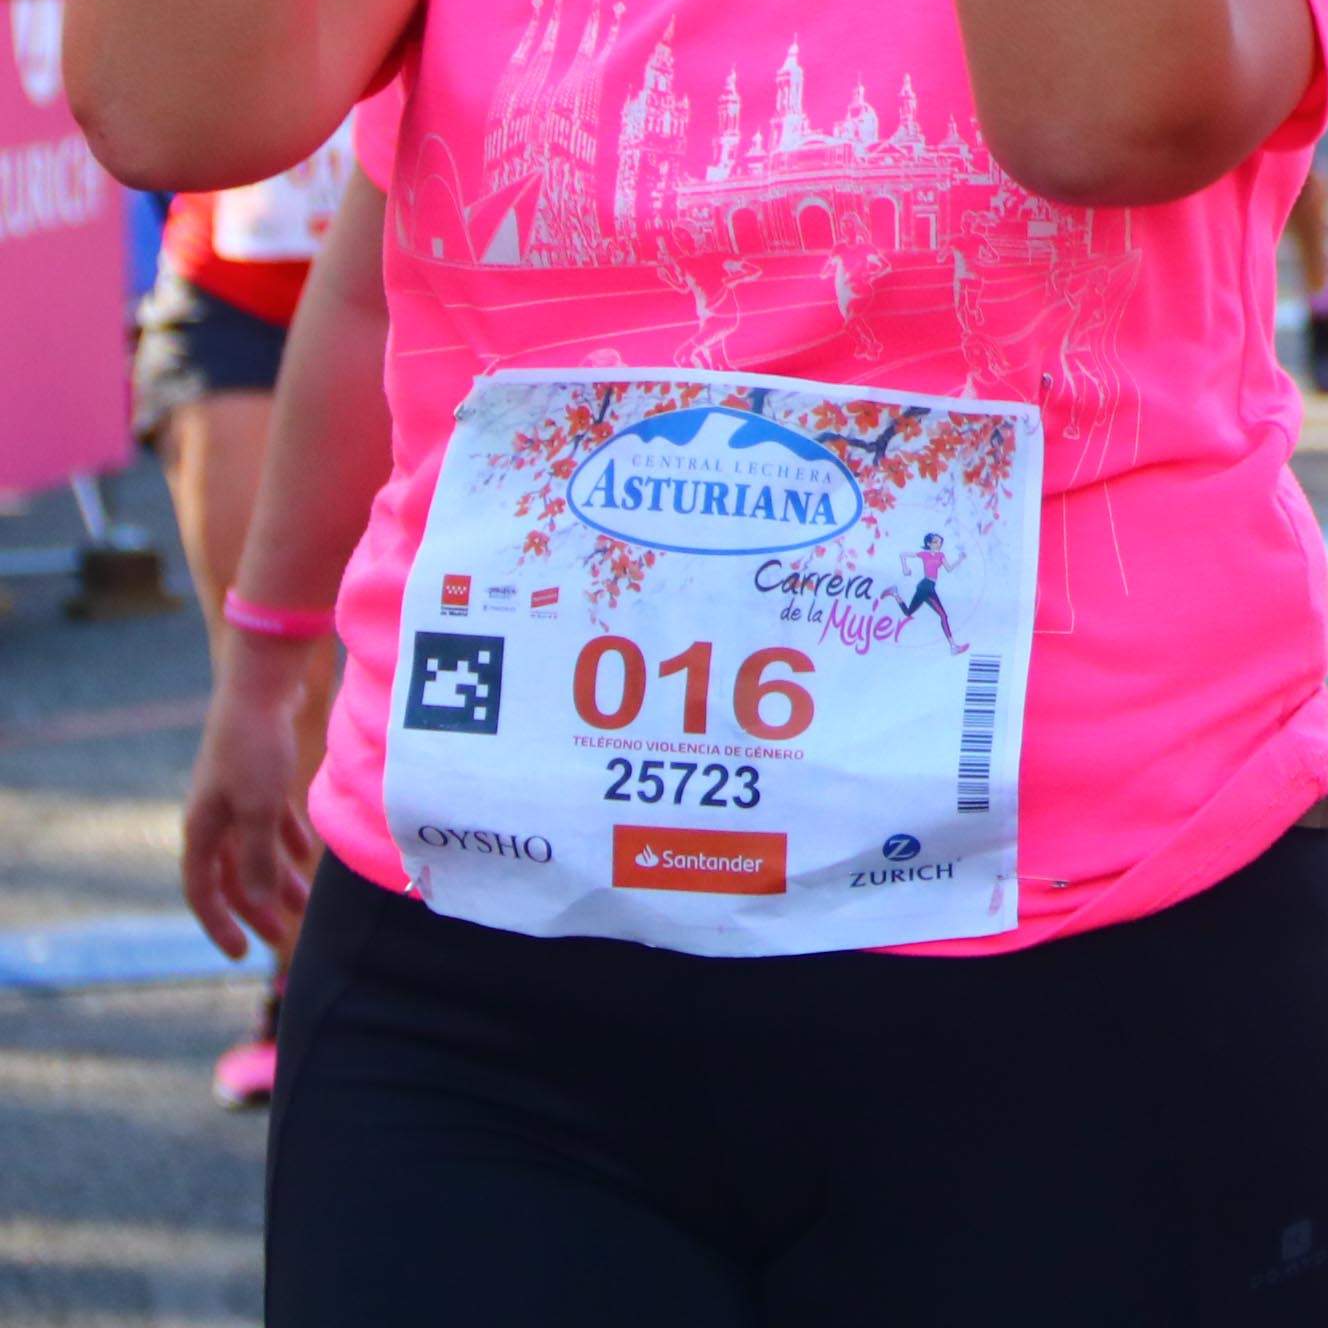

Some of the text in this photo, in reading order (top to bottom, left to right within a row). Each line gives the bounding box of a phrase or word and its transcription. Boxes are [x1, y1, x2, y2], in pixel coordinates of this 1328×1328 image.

[631, 453, 834, 485] CENTRAL LECHERA
[582, 458, 838, 527] ASTURIANA
[754, 558, 875, 602] Carrera
[780, 596, 914, 656] de la Mujer
[571, 634, 817, 742] 016
[573, 735, 804, 761] TELÉFONO VIOLENCIA DE GÉNERO
[603, 756, 761, 809] 25723
[417, 824, 554, 865] OYSHO
[661, 848, 764, 874] Santander
[850, 862, 955, 889] ZURICH
